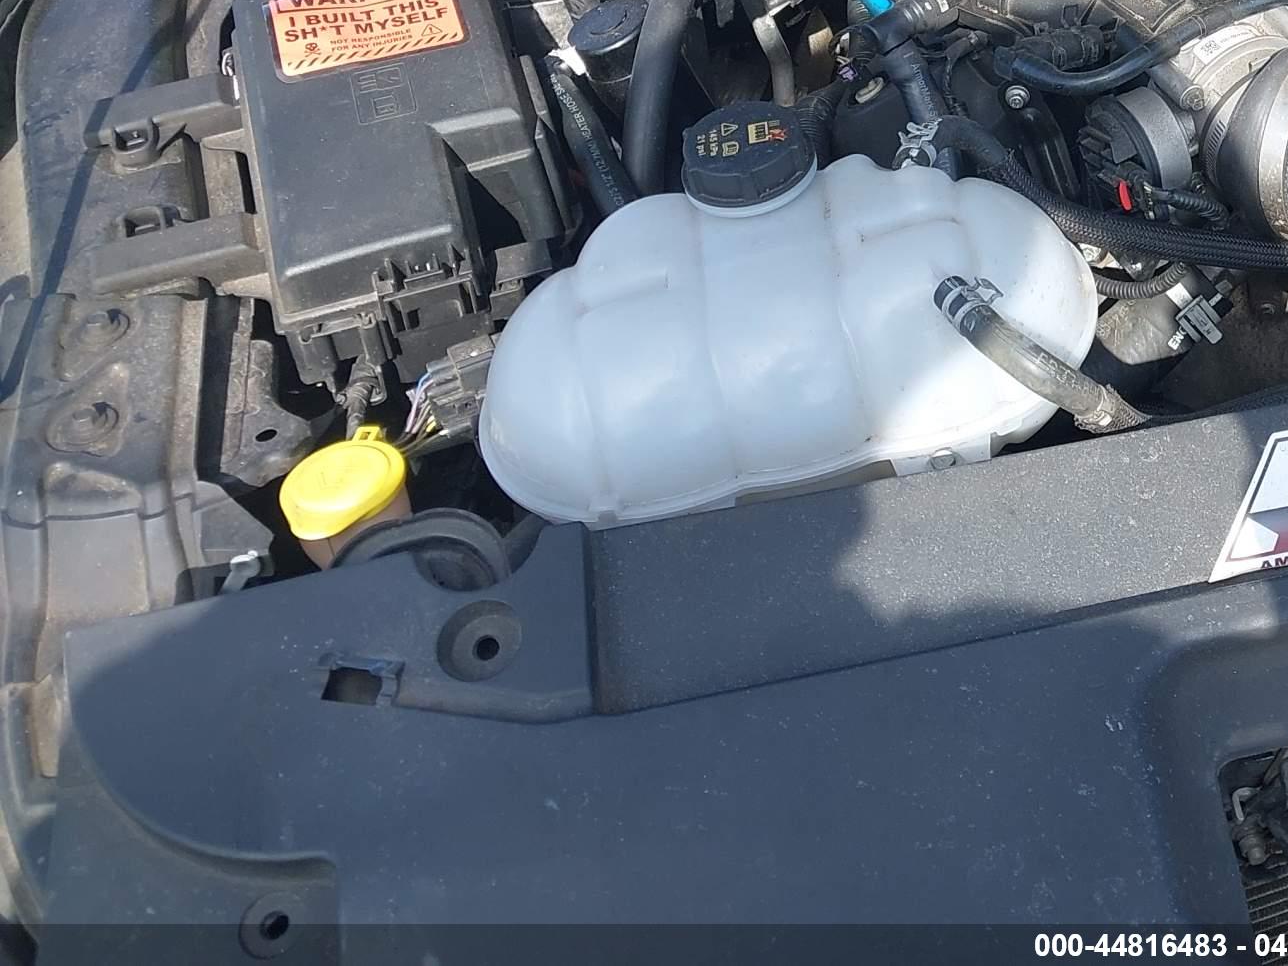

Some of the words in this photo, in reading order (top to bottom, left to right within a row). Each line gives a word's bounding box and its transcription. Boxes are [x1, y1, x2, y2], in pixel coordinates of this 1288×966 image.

[289, 17, 296, 27] I
[306, 10, 374, 26] BUILT
[355, 7, 449, 35] MYSELF
[351, 29, 412, 43] RESPONSIBLE
[372, 34, 414, 47] INJURIES
[560, 93, 580, 113] HOSE
[574, 111, 593, 139] HEATER
